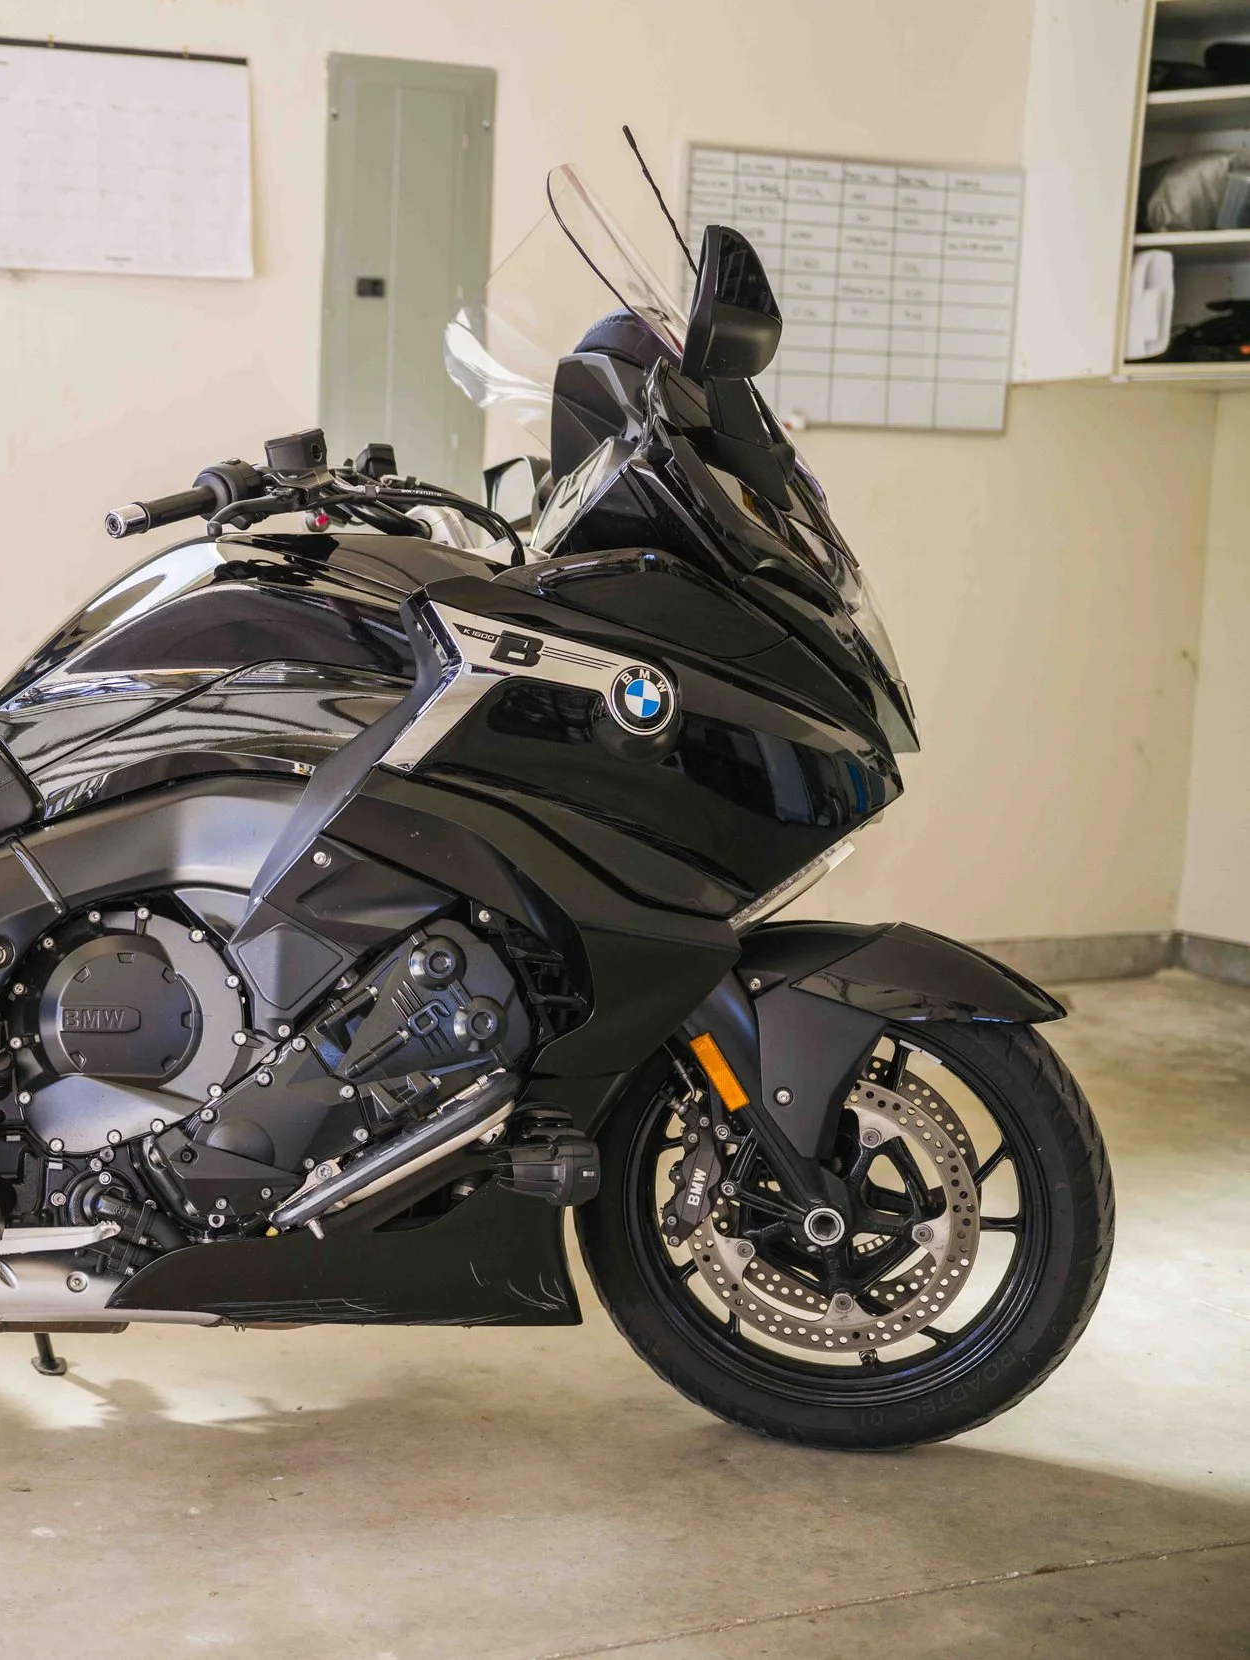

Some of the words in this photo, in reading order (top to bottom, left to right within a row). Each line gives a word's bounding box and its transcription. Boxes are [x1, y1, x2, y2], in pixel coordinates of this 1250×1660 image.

[472, 630, 495, 641] 1600
[489, 630, 545, 667] B
[621, 669, 668, 693] BMW
[62, 1009, 125, 1029] BMW
[687, 1167, 707, 1207] BMW
[905, 1350, 1017, 1421] ROADTEC
